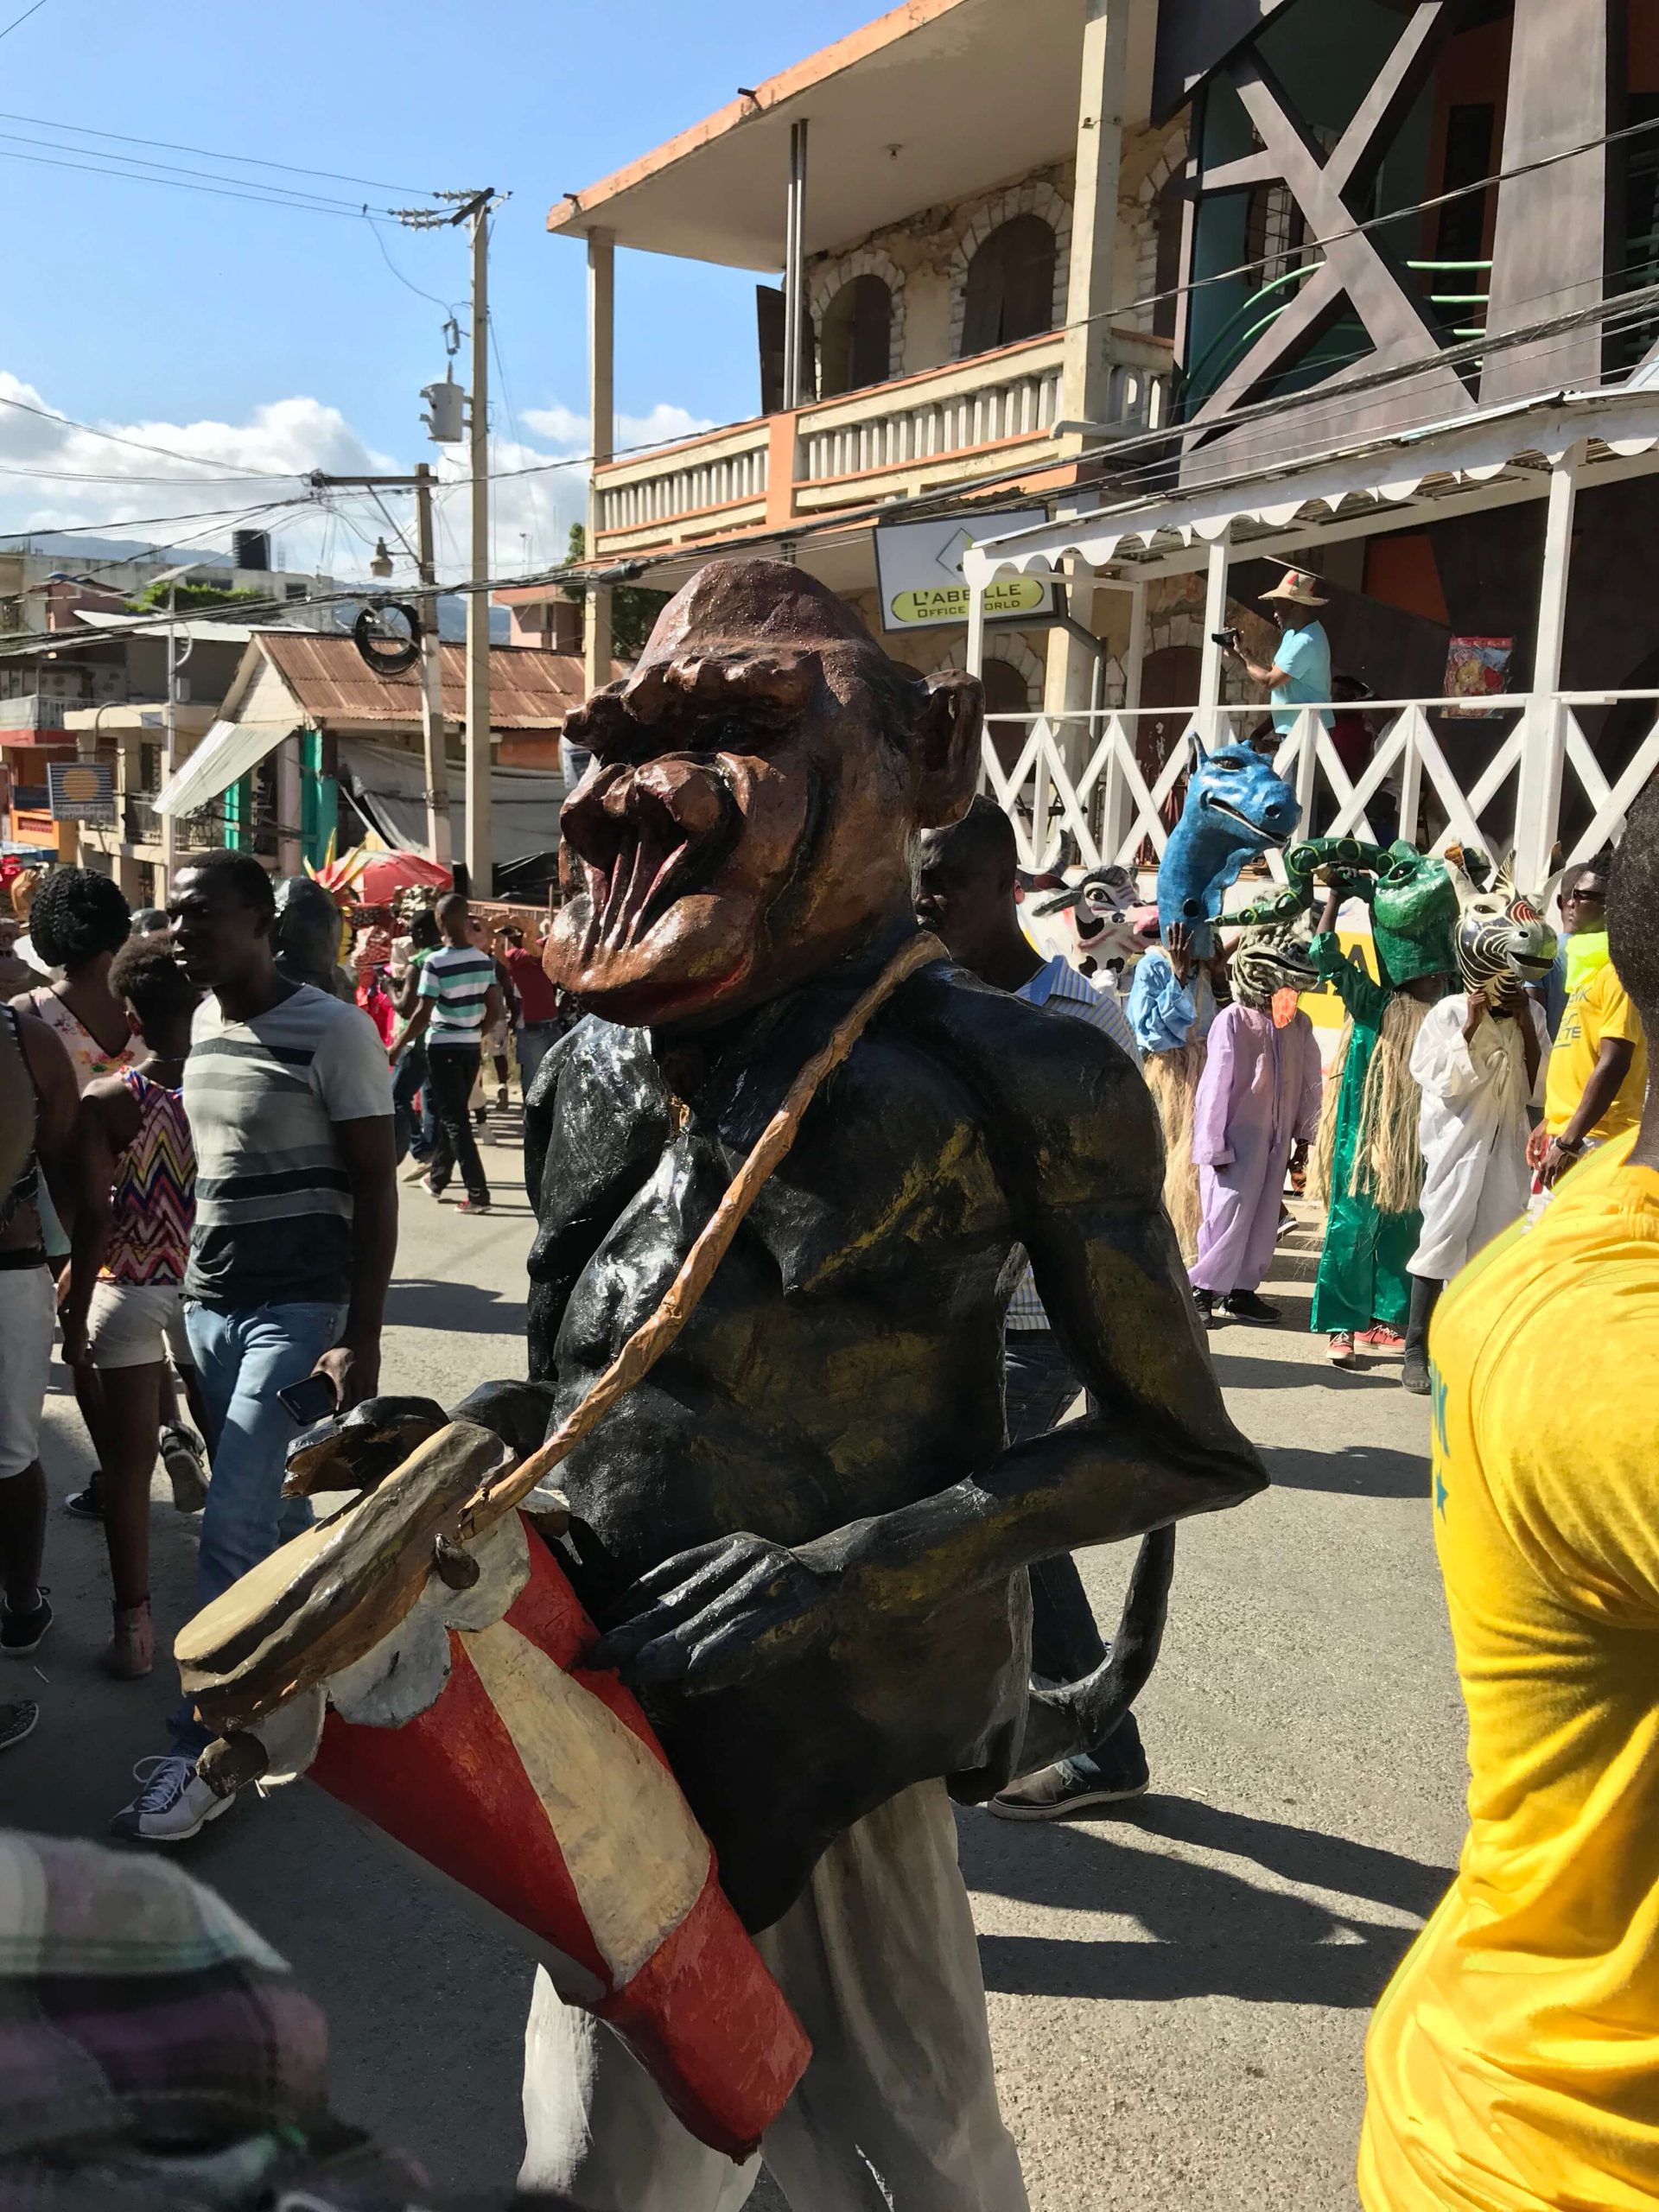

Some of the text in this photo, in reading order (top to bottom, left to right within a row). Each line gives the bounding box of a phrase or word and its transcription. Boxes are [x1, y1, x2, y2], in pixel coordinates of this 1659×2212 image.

[912, 583, 1021, 607] L'ABELLE
[917, 600, 1020, 618] OFFICE ORLD
